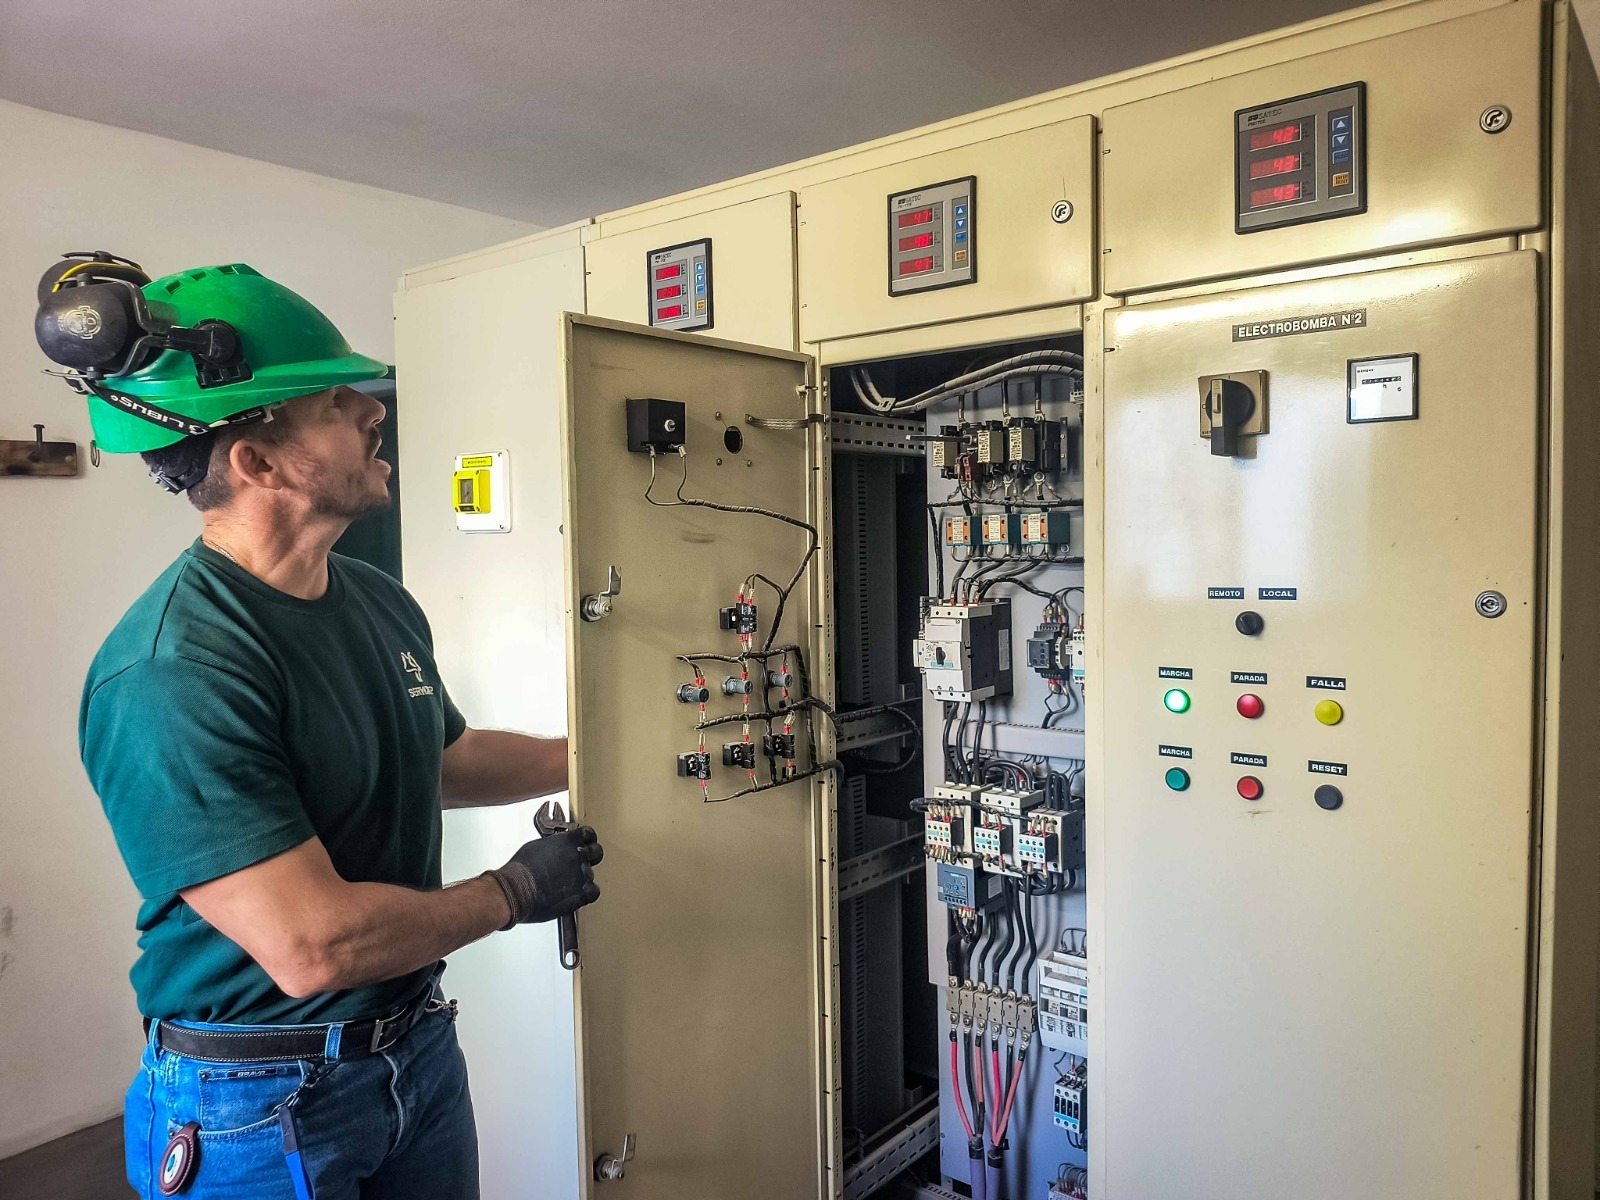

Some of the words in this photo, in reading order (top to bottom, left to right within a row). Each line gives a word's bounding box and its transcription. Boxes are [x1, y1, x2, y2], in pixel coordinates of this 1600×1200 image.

[1238, 315, 1336, 338] ELECTROBOMBA
[1160, 669, 1190, 678] MARCHA
[1233, 674, 1265, 682] PARADA
[1311, 679, 1345, 688] FALLA
[1161, 747, 1191, 757] MARCHA
[1233, 755, 1264, 765] PARADA
[1311, 763, 1344, 774] RESET
